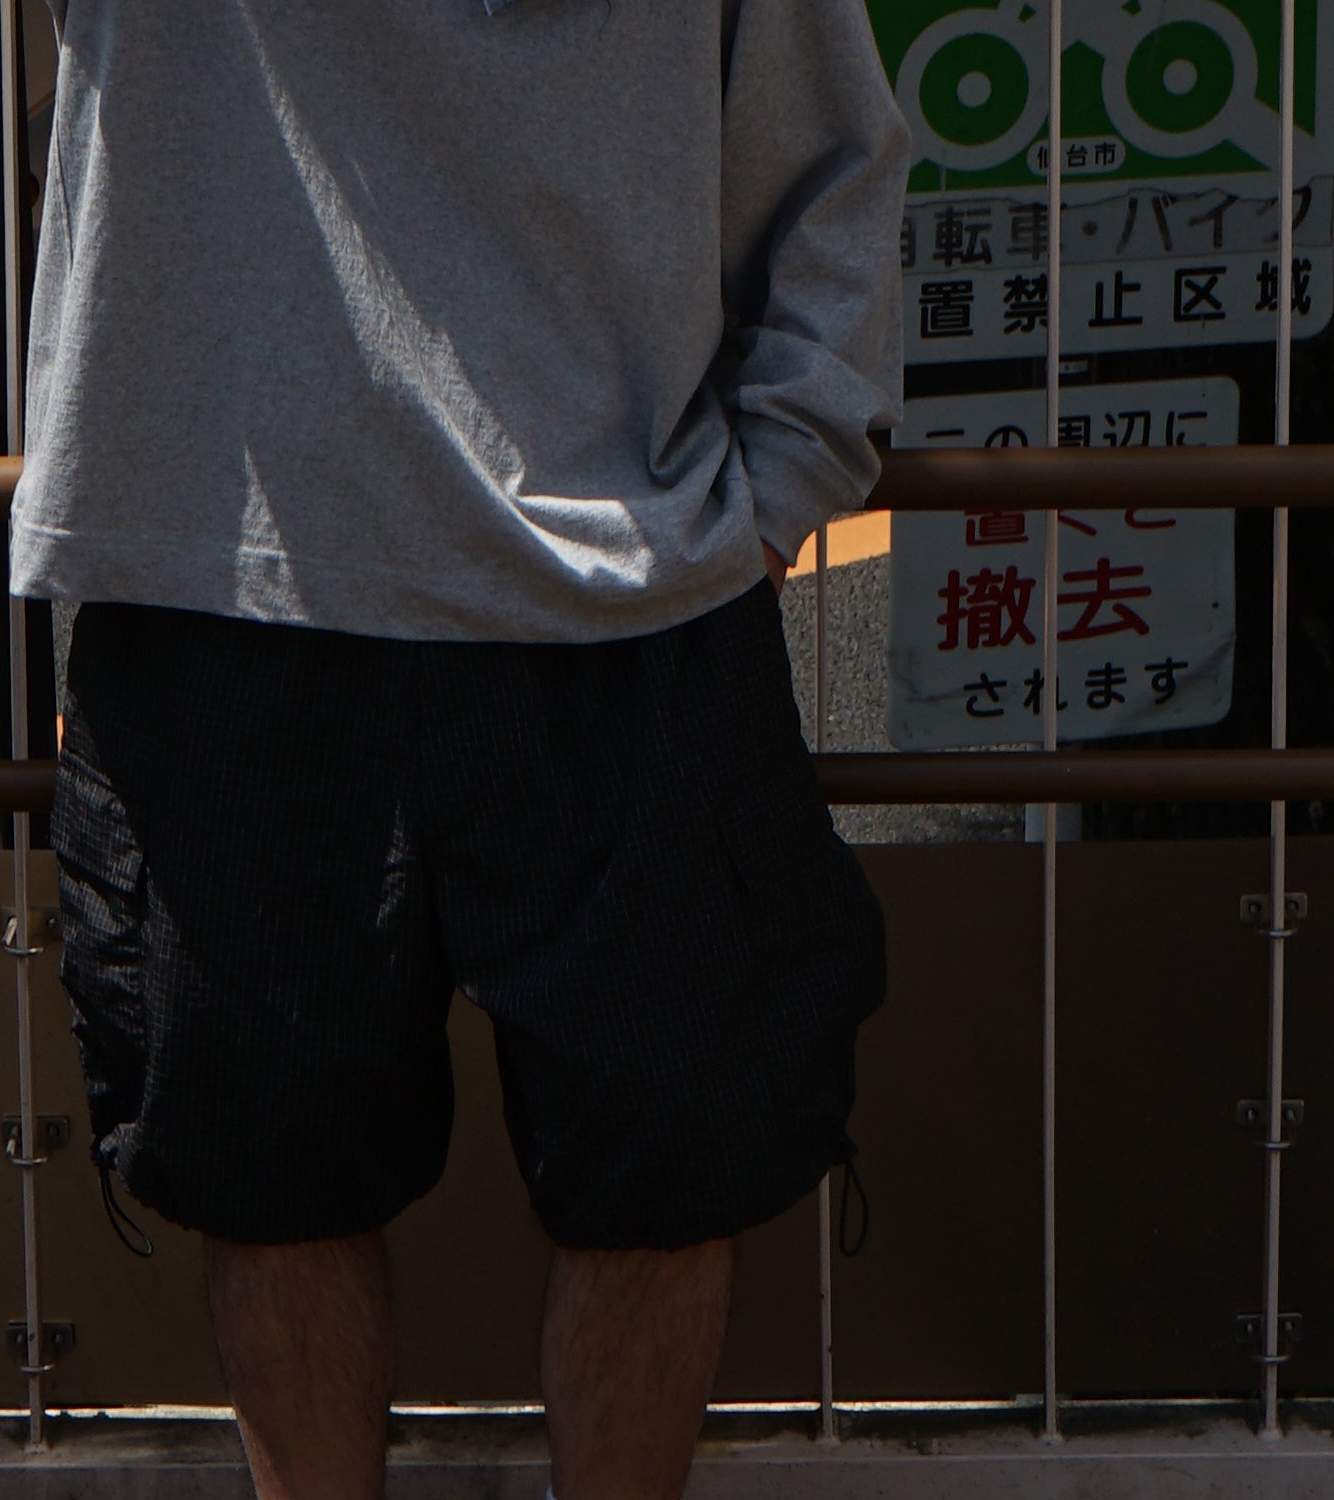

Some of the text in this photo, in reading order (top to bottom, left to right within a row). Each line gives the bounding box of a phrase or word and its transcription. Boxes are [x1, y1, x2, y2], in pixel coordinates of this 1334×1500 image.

[936, 557, 1152, 650] 撤去
[963, 657, 1189, 717] されます
